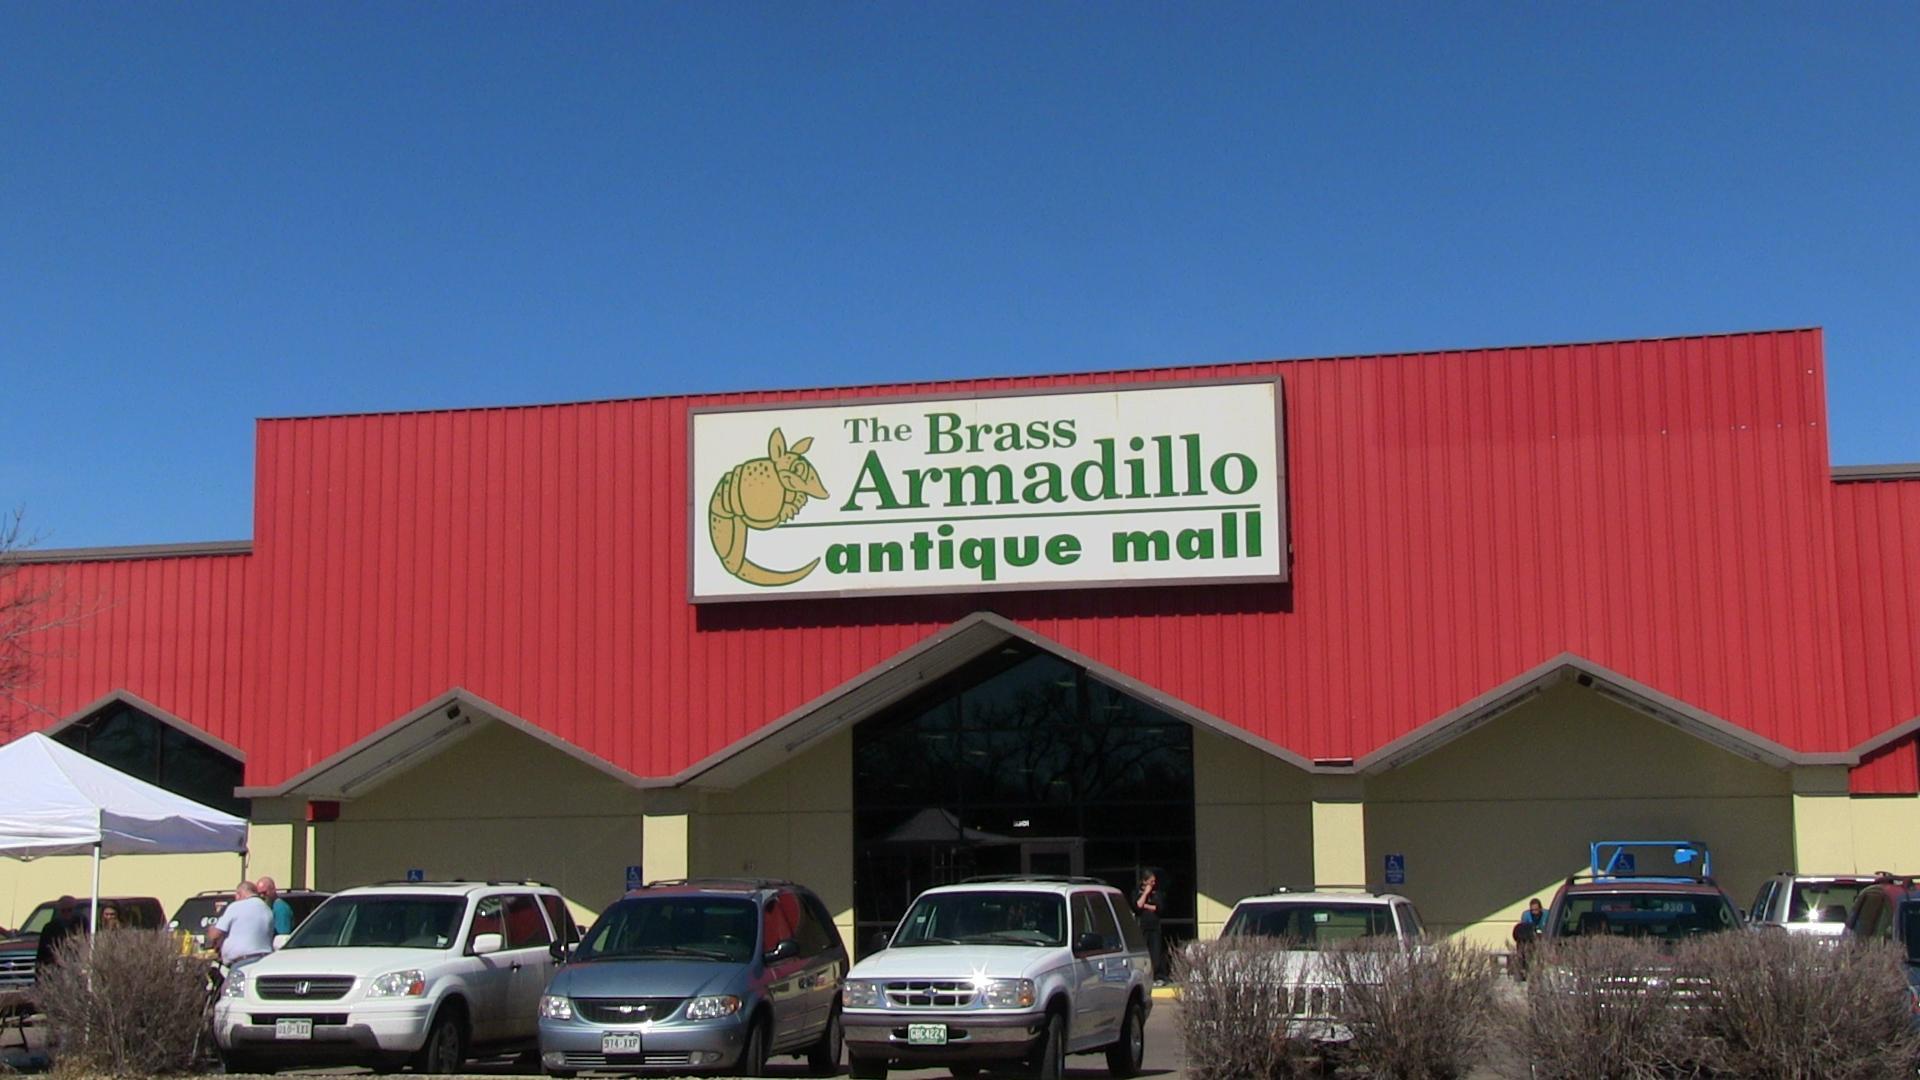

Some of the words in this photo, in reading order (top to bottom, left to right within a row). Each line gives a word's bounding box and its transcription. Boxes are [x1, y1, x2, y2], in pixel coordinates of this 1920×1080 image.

[844, 417, 913, 444] The
[924, 411, 1078, 455] Brass
[840, 433, 1259, 512] Armadillo
[825, 523, 1083, 582] antique
[1112, 511, 1263, 564] mall
